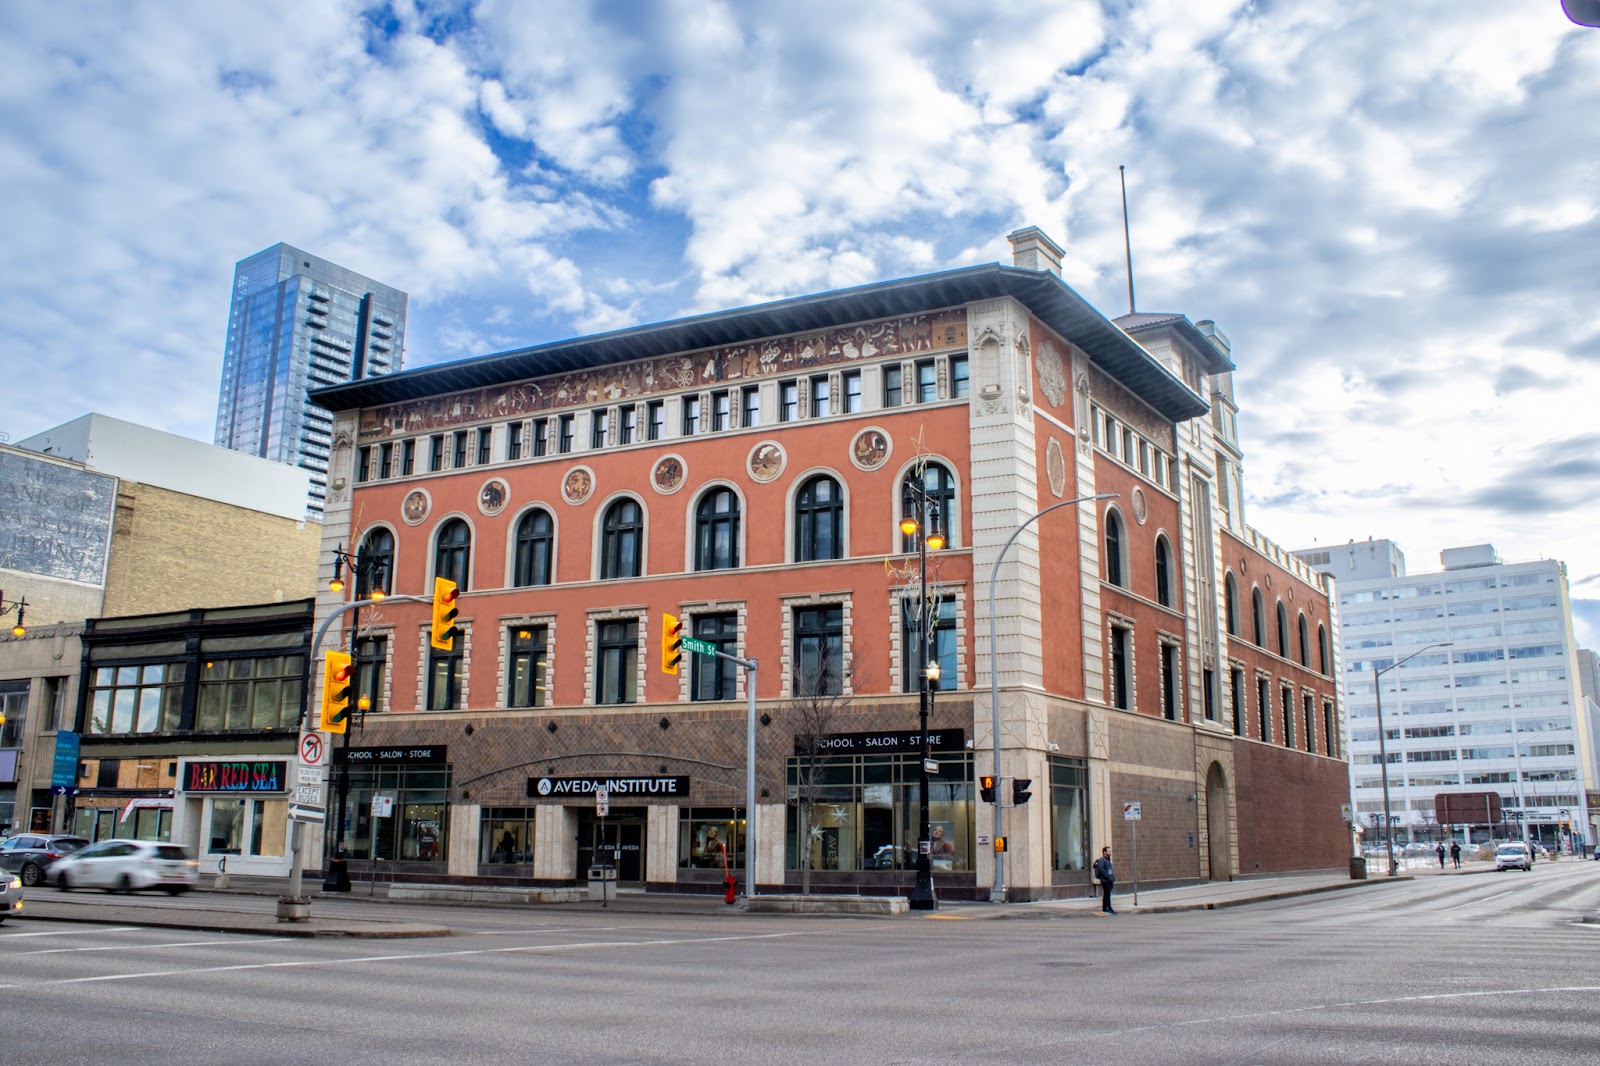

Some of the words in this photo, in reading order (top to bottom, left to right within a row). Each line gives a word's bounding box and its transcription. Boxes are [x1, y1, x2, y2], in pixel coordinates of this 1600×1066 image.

[682, 638, 704, 653] Smith
[707, 645, 715, 656] St
[865, 737, 898, 747] SALON
[380, 750, 402, 758] SALON
[410, 750, 432, 758] STORE
[190, 763, 218, 790] BAR
[220, 763, 250, 790] RED
[251, 763, 278, 790] SEA
[298, 786, 319, 795] EXCEPT
[554, 780, 598, 793] AVEDA
[606, 779, 677, 793] INSTITUTE
[299, 794, 317, 802] BUSES
[828, 834, 837, 860] AVE
